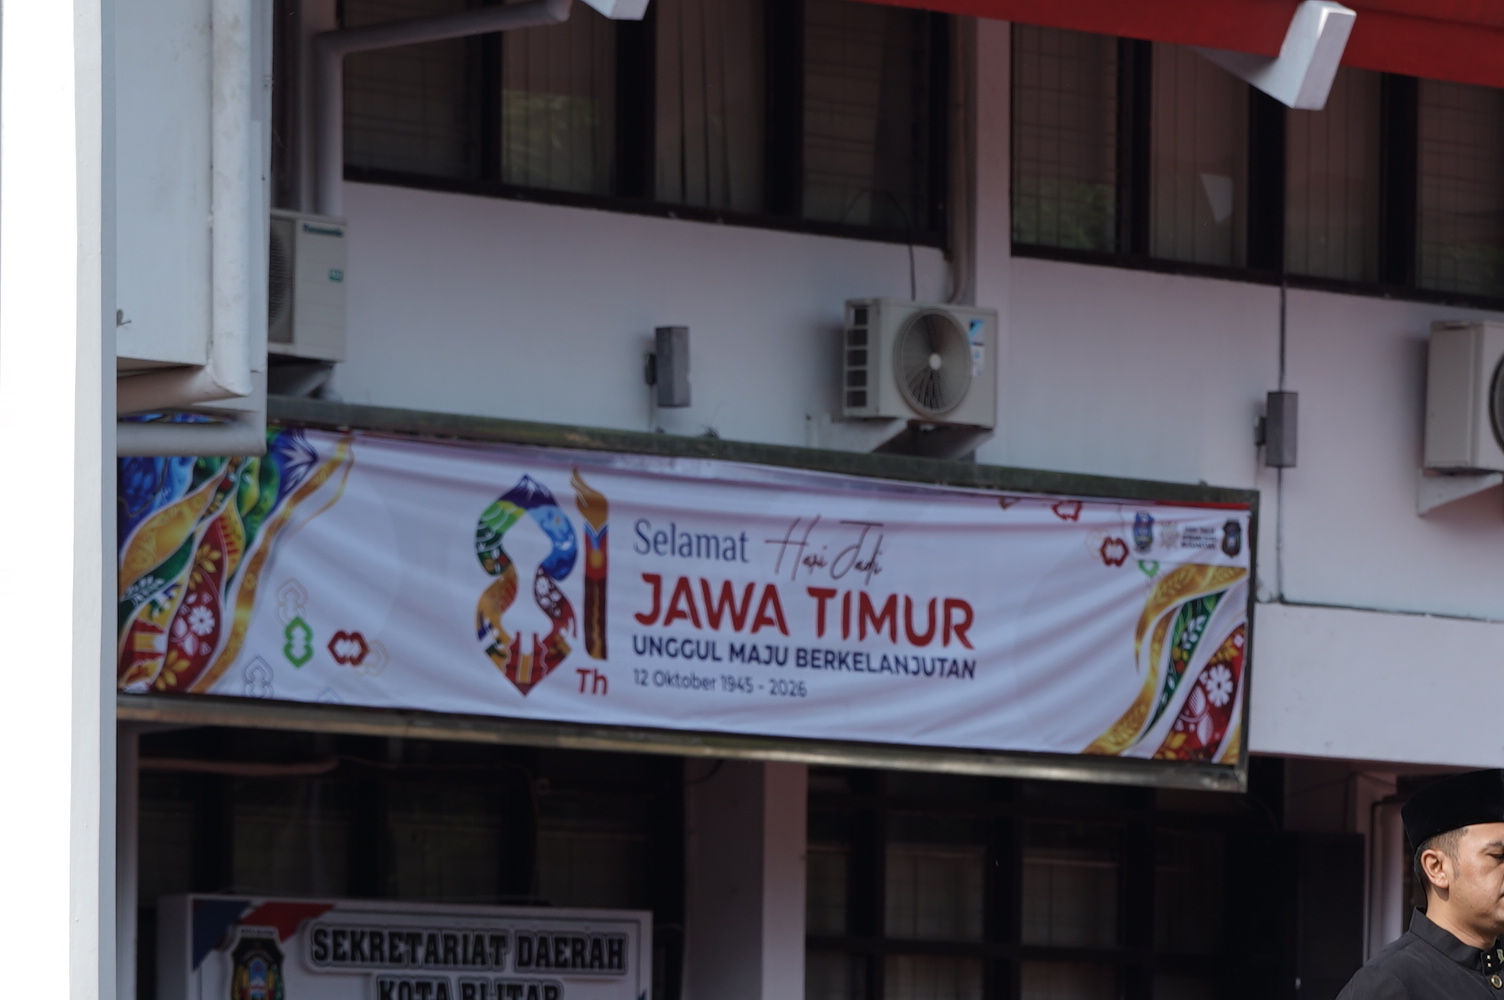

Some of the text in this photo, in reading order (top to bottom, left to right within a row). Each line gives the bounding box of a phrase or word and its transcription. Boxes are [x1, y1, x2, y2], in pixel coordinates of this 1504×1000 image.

[634, 514, 884, 585] Selamat Hari Jadi
[634, 572, 975, 650] JAWA TIMUR
[633, 635, 976, 680] UNGGUL MAJU BERKELANJUTAN
[576, 668, 609, 696] Th
[634, 669, 650, 687] 12
[652, 670, 716, 692] Oktober
[721, 675, 754, 694] 1945
[770, 678, 808, 697] 2026
[313, 928, 625, 970] SEKRETARIAT DAERAH
